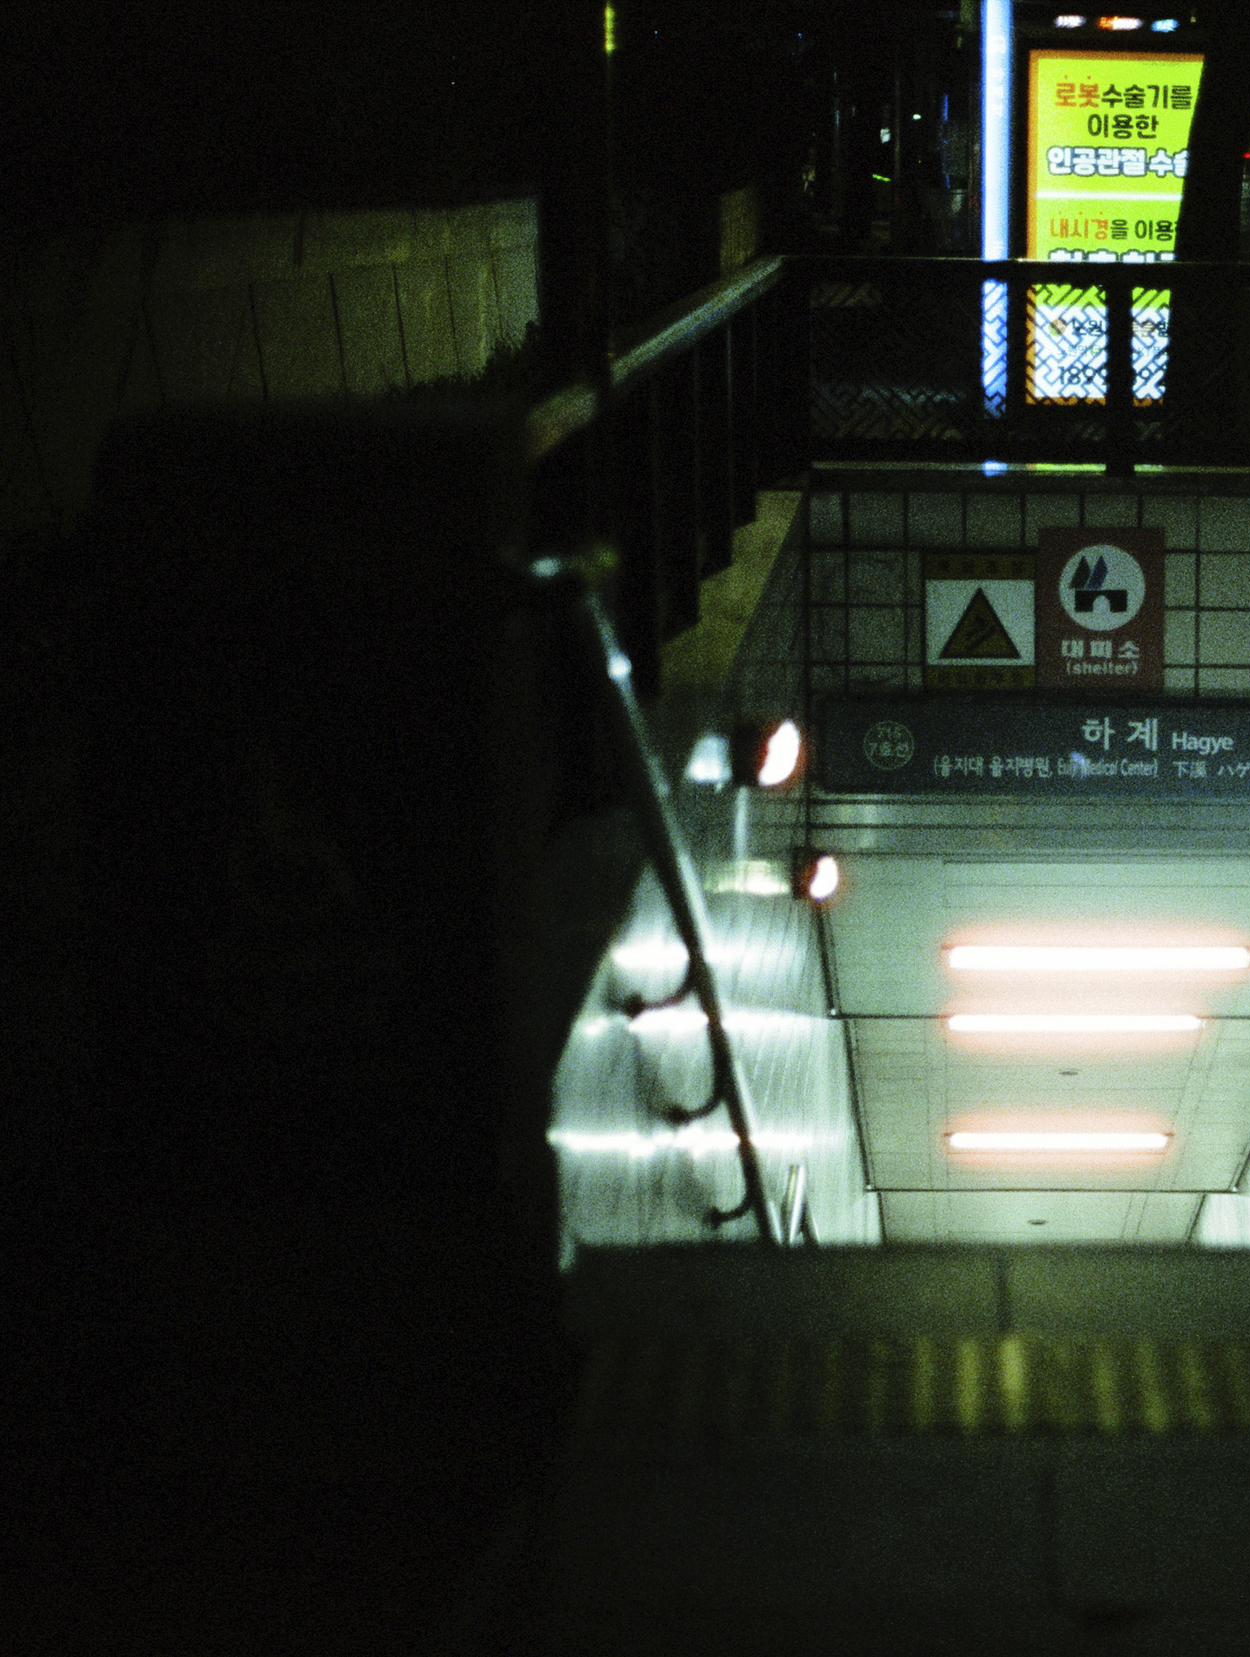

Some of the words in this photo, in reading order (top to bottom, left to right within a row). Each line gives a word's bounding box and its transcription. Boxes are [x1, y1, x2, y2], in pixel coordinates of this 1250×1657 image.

[1055, 82, 1193, 110] 로봇수술기를
[1087, 113, 1159, 139] 이용한
[1049, 217, 1128, 241] 내시경을
[1172, 731, 1234, 755] Hagye
